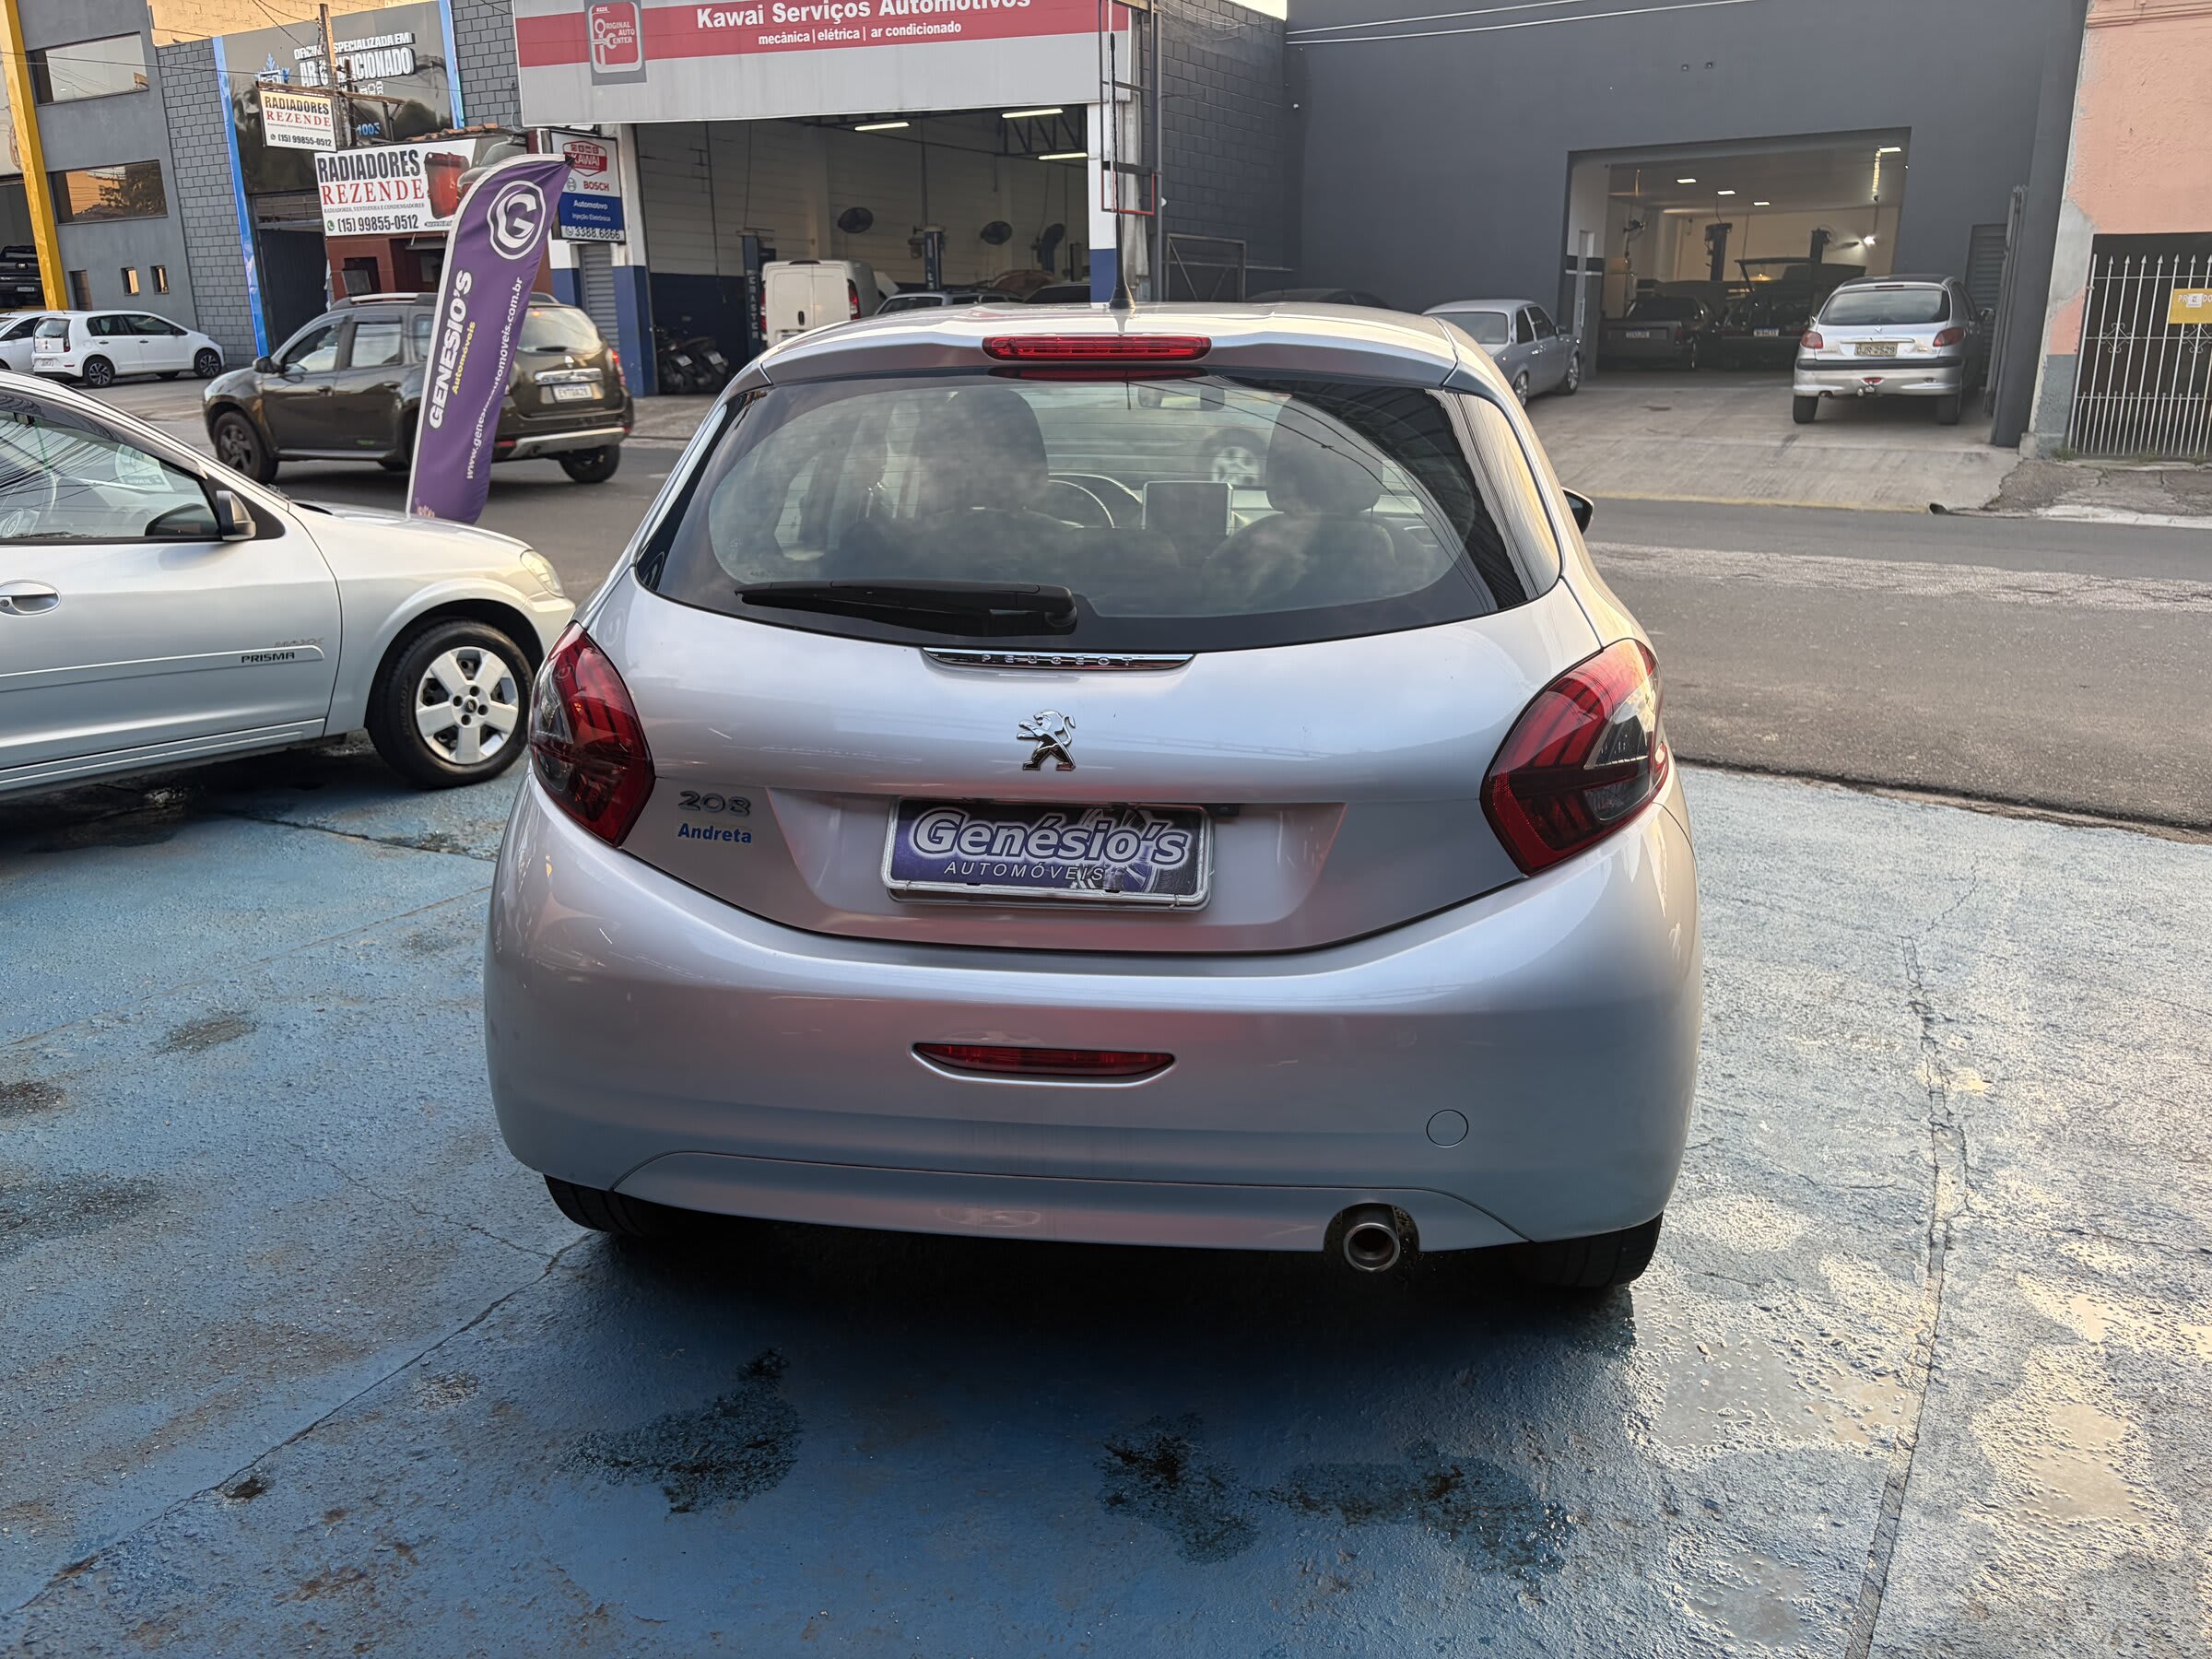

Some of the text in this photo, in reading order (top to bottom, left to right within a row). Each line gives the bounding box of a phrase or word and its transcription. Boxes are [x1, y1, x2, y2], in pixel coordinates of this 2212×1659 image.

[697, 5, 764, 29] Kawai
[772, 0, 871, 24] Serviços
[332, 35, 394, 53] SPECIALIZADA
[394, 32, 414, 44] EM
[618, 28, 635, 36] AUTO
[758, 21, 961, 45] mecânica elétrica ar condicionado
[300, 61, 317, 87] AR
[318, 47, 414, 86] CNICIONADO
[265, 96, 329, 115] RADIADORES
[266, 111, 332, 127] REZENDE
[277, 134, 332, 147] (15) 99855-0512
[317, 149, 421, 182] RADIADORES
[321, 179, 425, 206] REZENDE
[583, 181, 609, 192] BOSCH
[337, 218, 357, 232] (15)
[359, 214, 419, 231] 99855-0512
[429, 270, 472, 429] GENESIO'S
[466, 276, 523, 479] www.genesiutomoveis.com.br
[241, 652, 295, 664] PRISMA
[982, 653, 1133, 666] PEUGEOT
[677, 791, 751, 818] 208
[677, 823, 752, 843] Andreta
[913, 809, 1189, 865] Genésio's
[944, 860, 1104, 881] AUTOMÓVEIS
